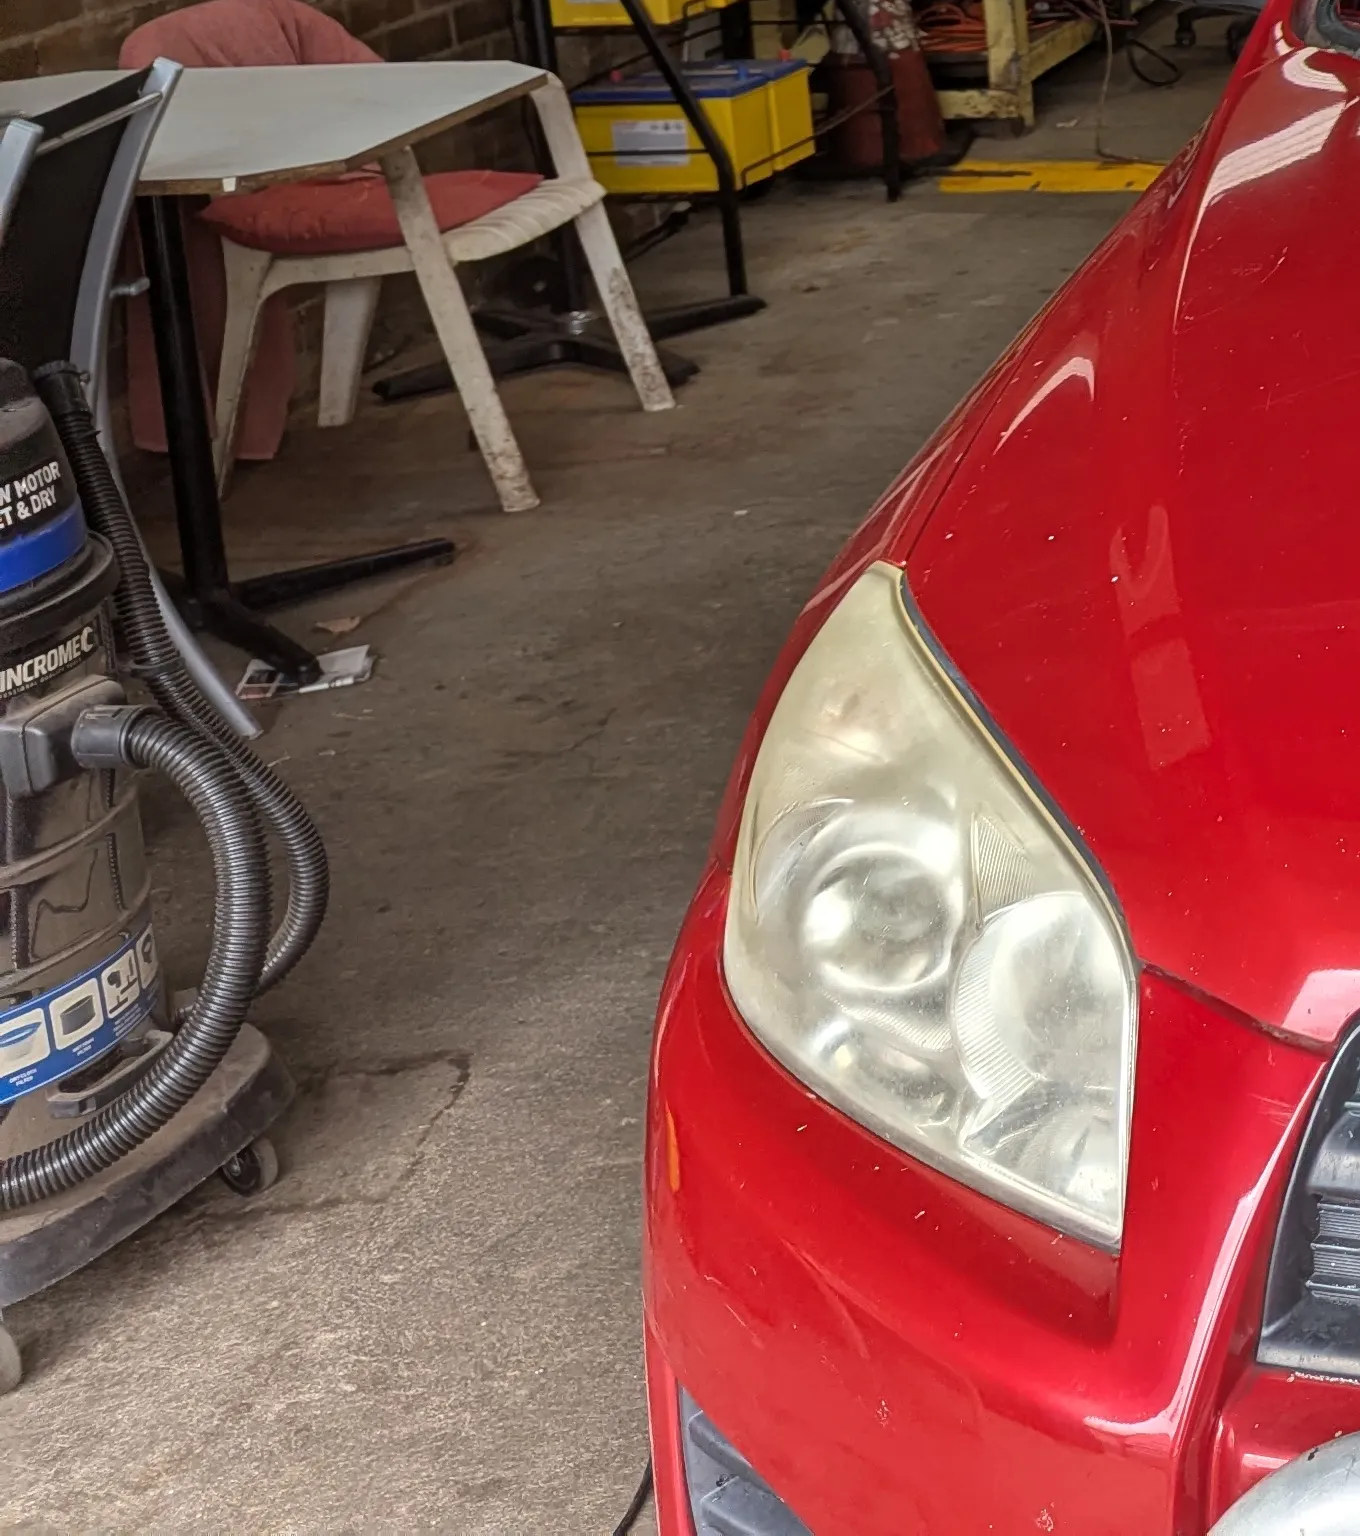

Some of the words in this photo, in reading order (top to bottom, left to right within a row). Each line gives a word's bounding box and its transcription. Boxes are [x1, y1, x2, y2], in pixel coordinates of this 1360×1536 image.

[13, 461, 61, 499] MOTOR
[16, 501, 32, 520] &
[30, 485, 57, 514] DRY
